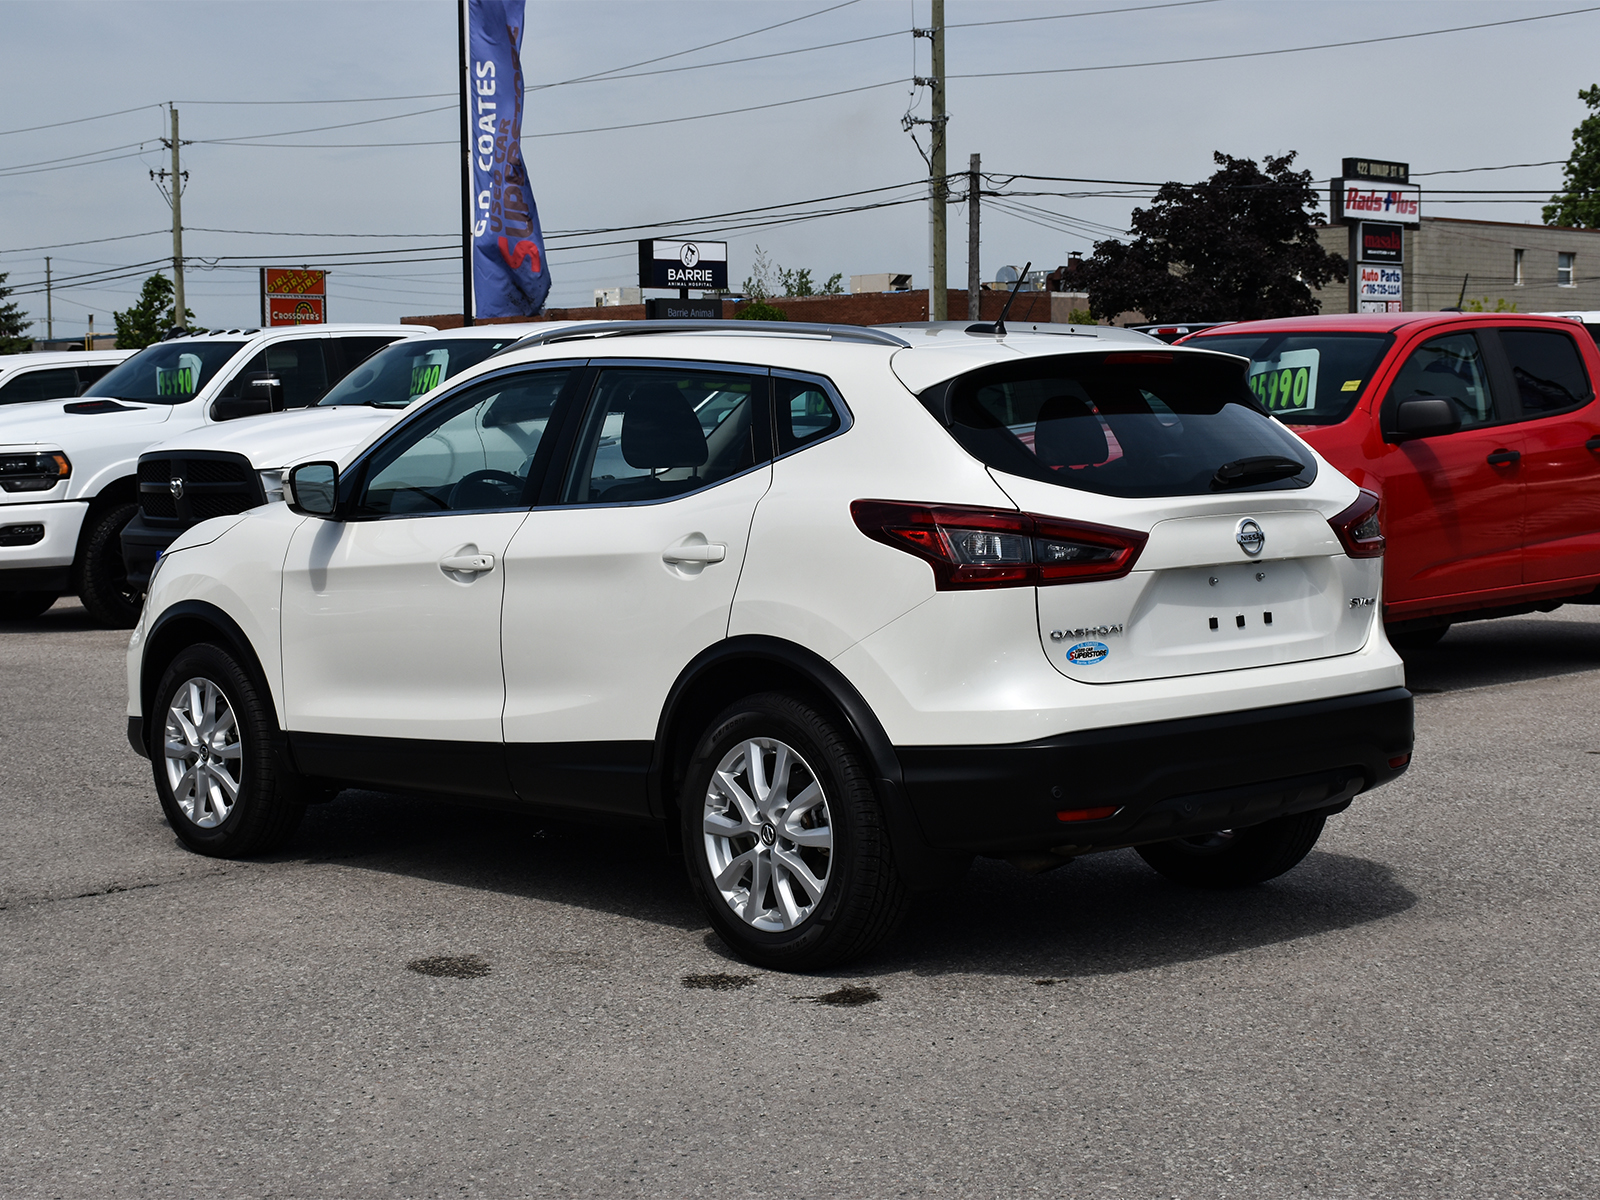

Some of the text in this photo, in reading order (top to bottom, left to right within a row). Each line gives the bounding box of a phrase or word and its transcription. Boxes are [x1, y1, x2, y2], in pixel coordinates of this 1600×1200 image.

[475, 60, 496, 237] G.D. COATES
[490, 118, 511, 233] USED CAR
[1357, 162, 1368, 175] 422
[1345, 187, 1383, 212] Rads
[267, 270, 294, 292] GIRLS
[282, 270, 308, 293] GIRLS
[297, 270, 323, 293] GIRLS
[668, 269, 712, 281] BARRIE
[1361, 268, 1400, 283] Auto Parts
[667, 308, 714, 318] Barrie Animal
[1240, 533, 1264, 542] NISSAN
[1050, 623, 1123, 641] QASHQAI
[1069, 649, 1107, 661] SUPERSTORE
